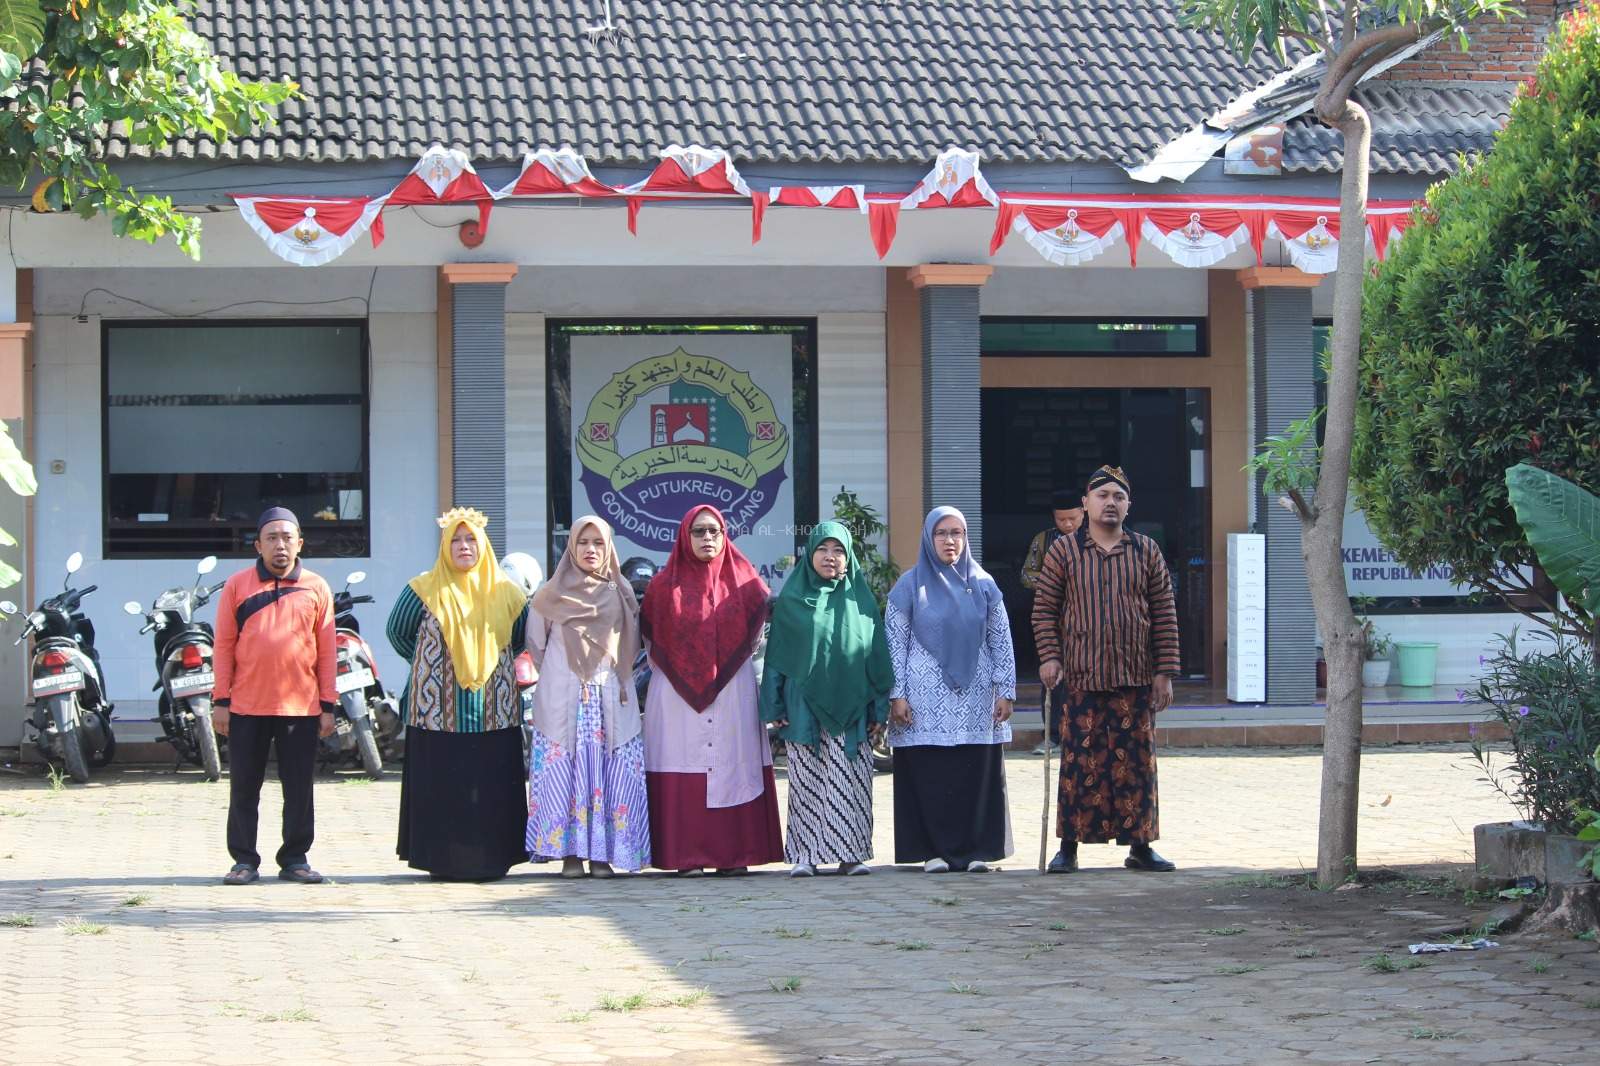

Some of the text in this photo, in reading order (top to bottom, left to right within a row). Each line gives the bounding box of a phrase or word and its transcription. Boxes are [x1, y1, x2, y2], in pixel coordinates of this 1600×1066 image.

[637, 479, 733, 504] PUTUKREJO
[601, 489, 765, 543] GONDANGL ALANG
[1340, 547, 1397, 563] KEMEN
